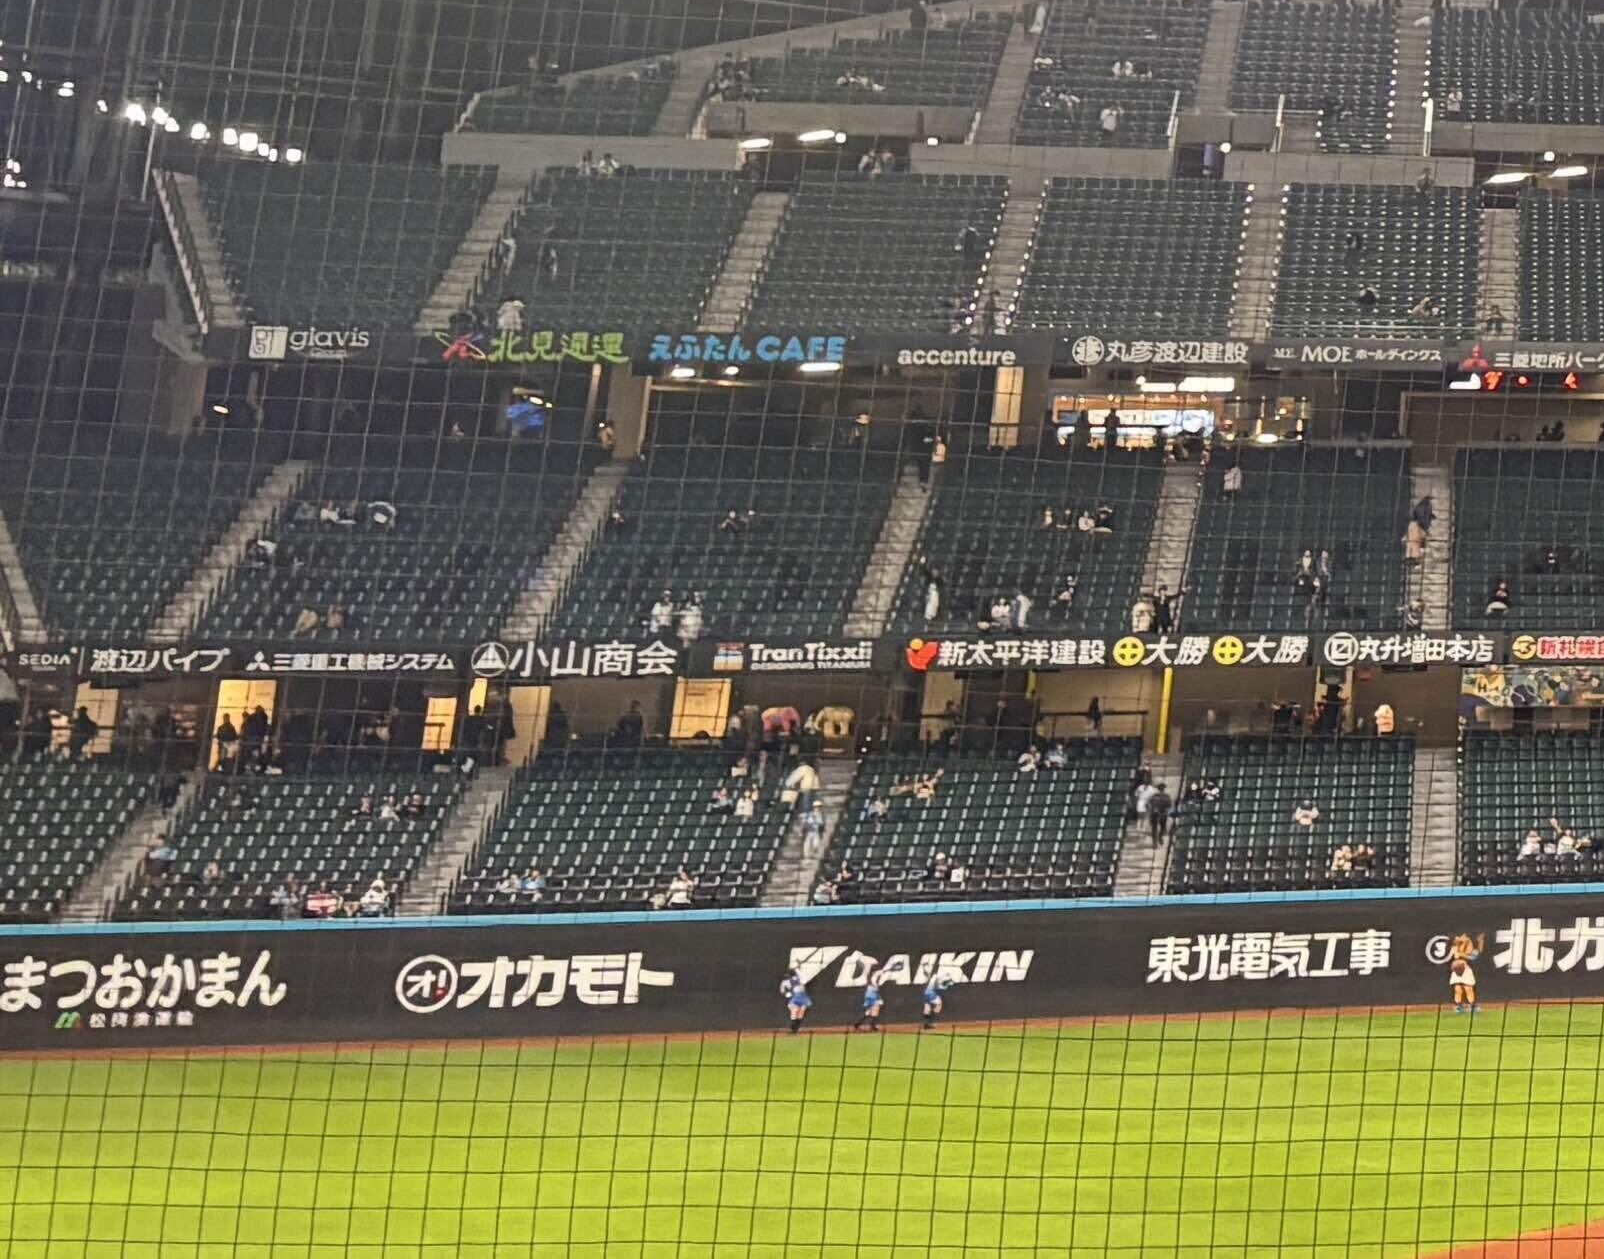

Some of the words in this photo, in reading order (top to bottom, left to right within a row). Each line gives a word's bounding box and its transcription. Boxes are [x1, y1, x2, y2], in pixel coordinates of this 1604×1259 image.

[289, 327, 370, 351] glavis
[488, 331, 631, 365] 北見通運
[649, 334, 752, 364] えふたん
[757, 335, 846, 362] CAFE
[1301, 346, 1353, 363] MOE
[1355, 347, 1442, 362] ホールディングス
[898, 347, 1016, 367] accenture
[19, 652, 71, 666] SEDIA
[509, 640, 679, 677] 小山商会
[749, 641, 873, 662] TranTixxii
[938, 640, 1106, 666] 新太平洋建設
[1143, 635, 1211, 667] 大勝
[1241, 634, 1309, 666] 大勝
[1360, 633, 1494, 661] 丸升増田本店
[835, 949, 1035, 988] DAIKIN
[1147, 928, 1391, 984] 東光電気工事
[0, 951, 287, 1011] まつおかまん
[456, 953, 675, 1008] オカモト
